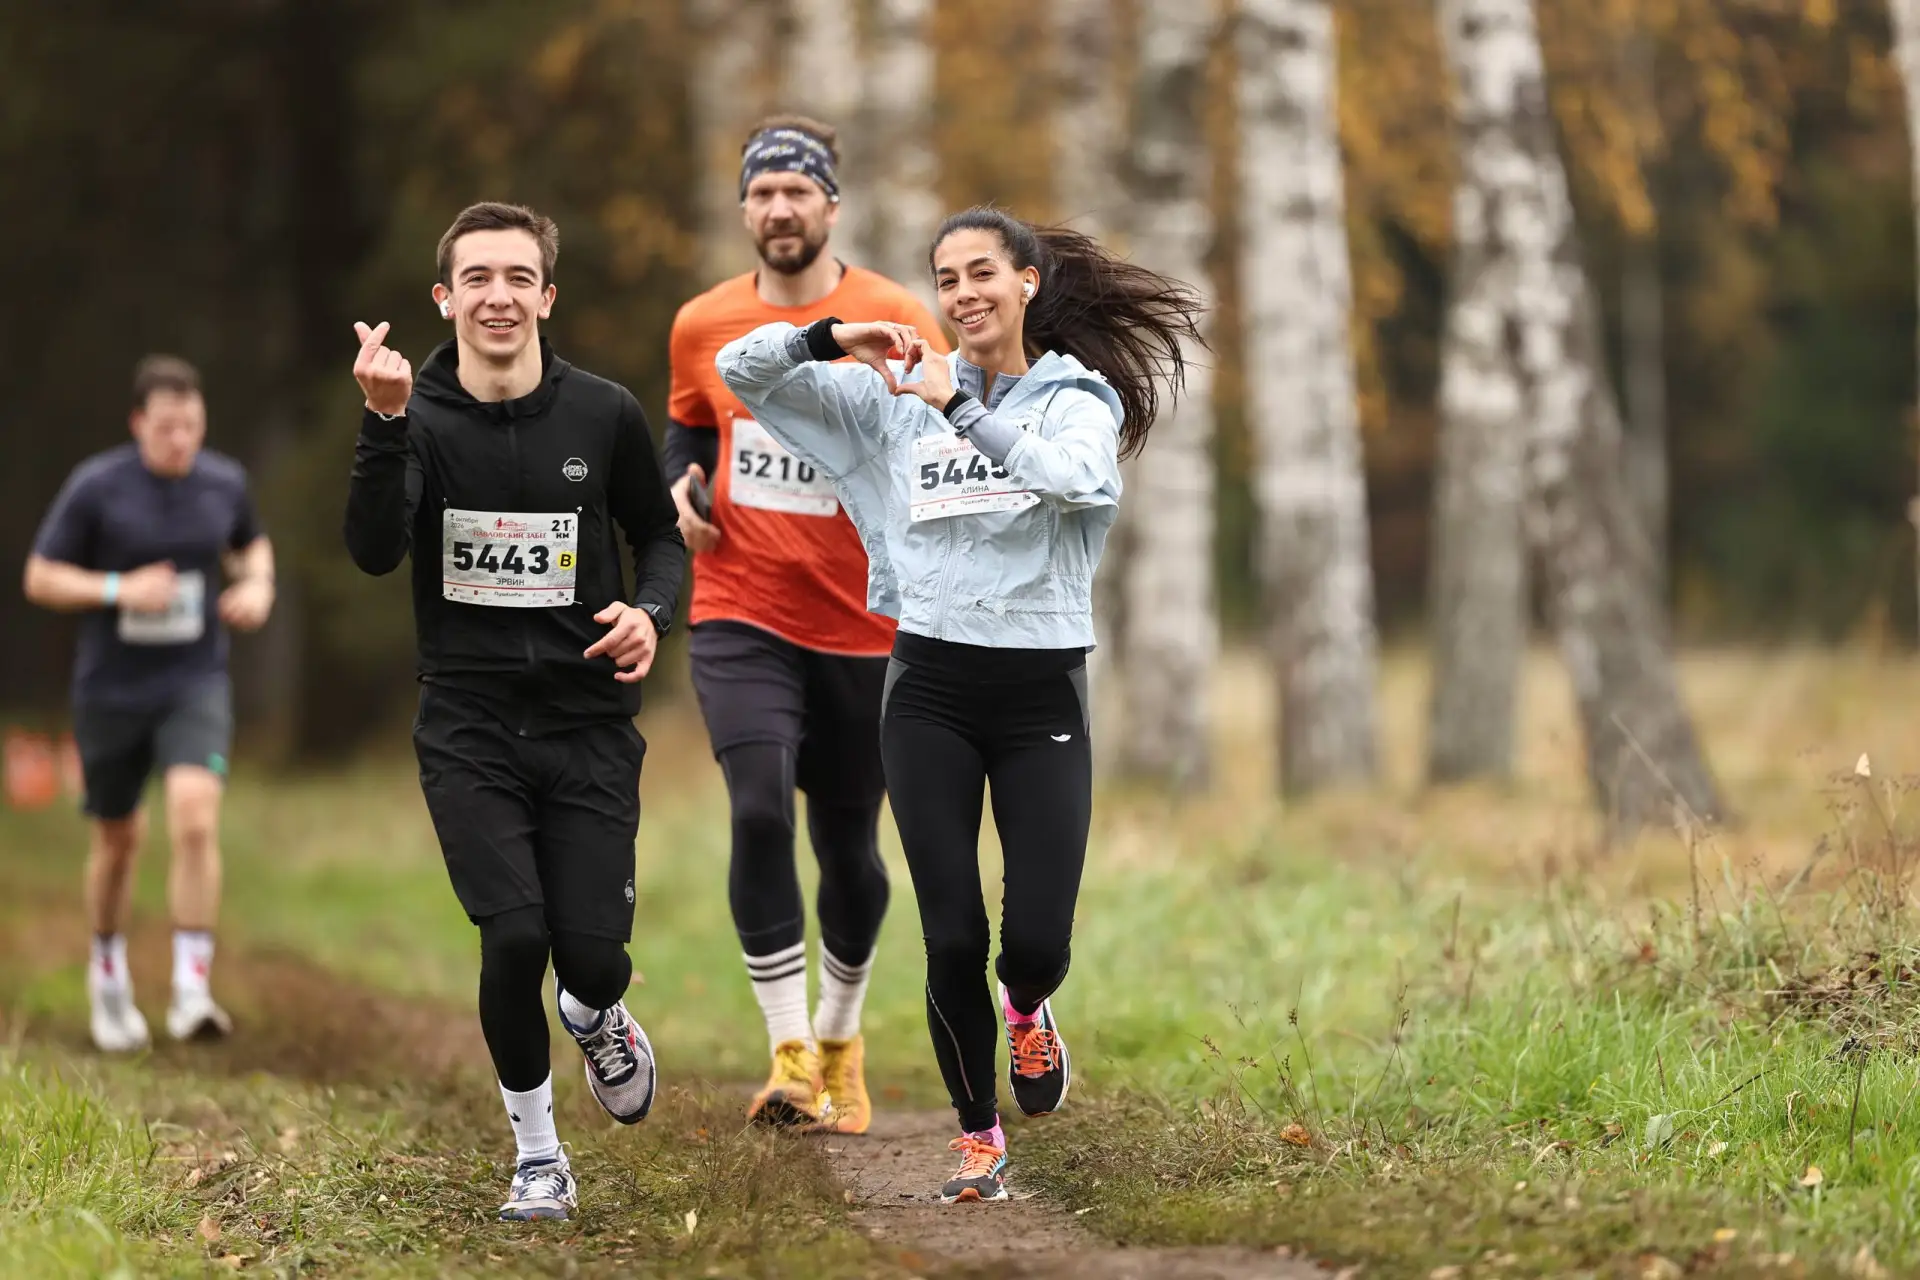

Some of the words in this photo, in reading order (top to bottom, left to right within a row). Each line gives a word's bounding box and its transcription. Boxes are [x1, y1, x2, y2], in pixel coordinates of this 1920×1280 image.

[739, 450, 815, 483] 5210
[961, 484, 990, 495] АЛИНА
[453, 541, 550, 575] 5443
[495, 577, 525, 586] ЭРВИН
